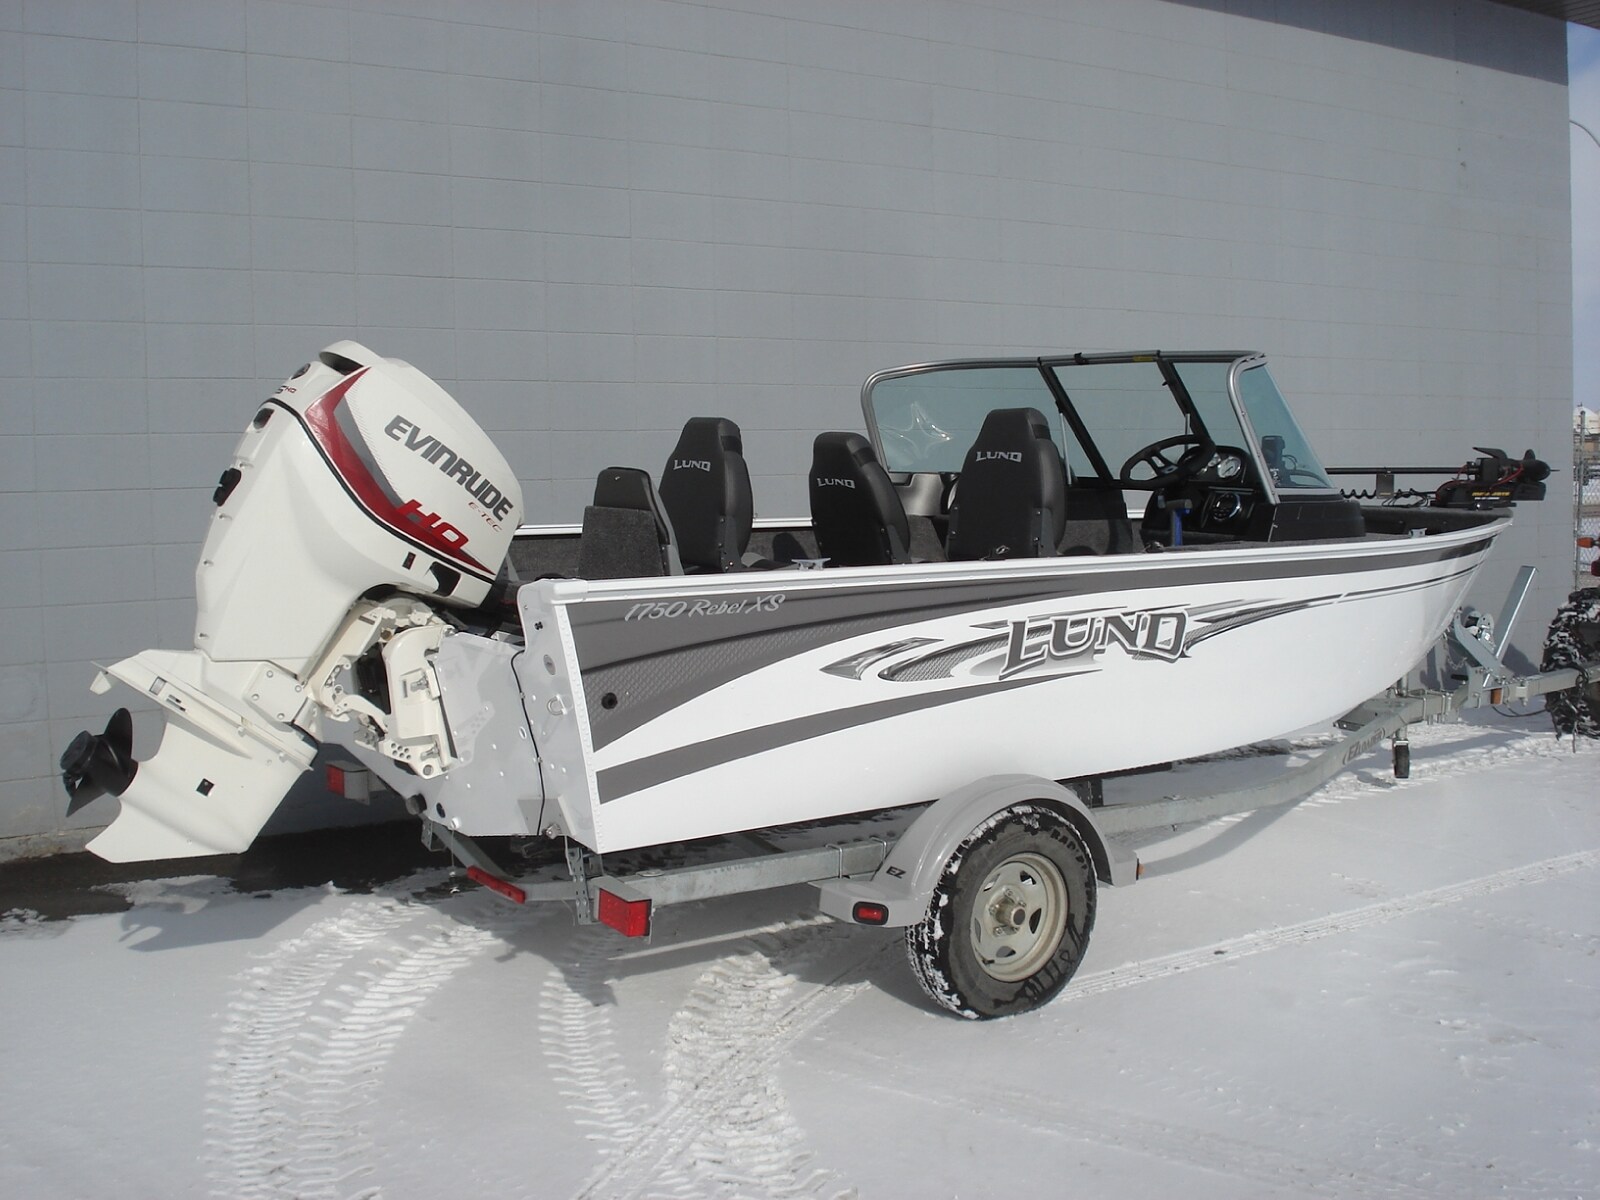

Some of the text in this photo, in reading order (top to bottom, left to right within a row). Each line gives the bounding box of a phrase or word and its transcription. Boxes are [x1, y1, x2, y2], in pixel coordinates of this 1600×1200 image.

[384, 415, 514, 522] EVINRUDE
[673, 459, 711, 472] LUND
[976, 451, 1022, 463] LUND
[816, 477, 856, 489] LUND
[396, 499, 469, 549] HO
[468, 501, 502, 532] E-TEC
[624, 593, 786, 621] 1750 Rebel XS
[999, 610, 1187, 680] LUND
[886, 866, 907, 879] EZ
